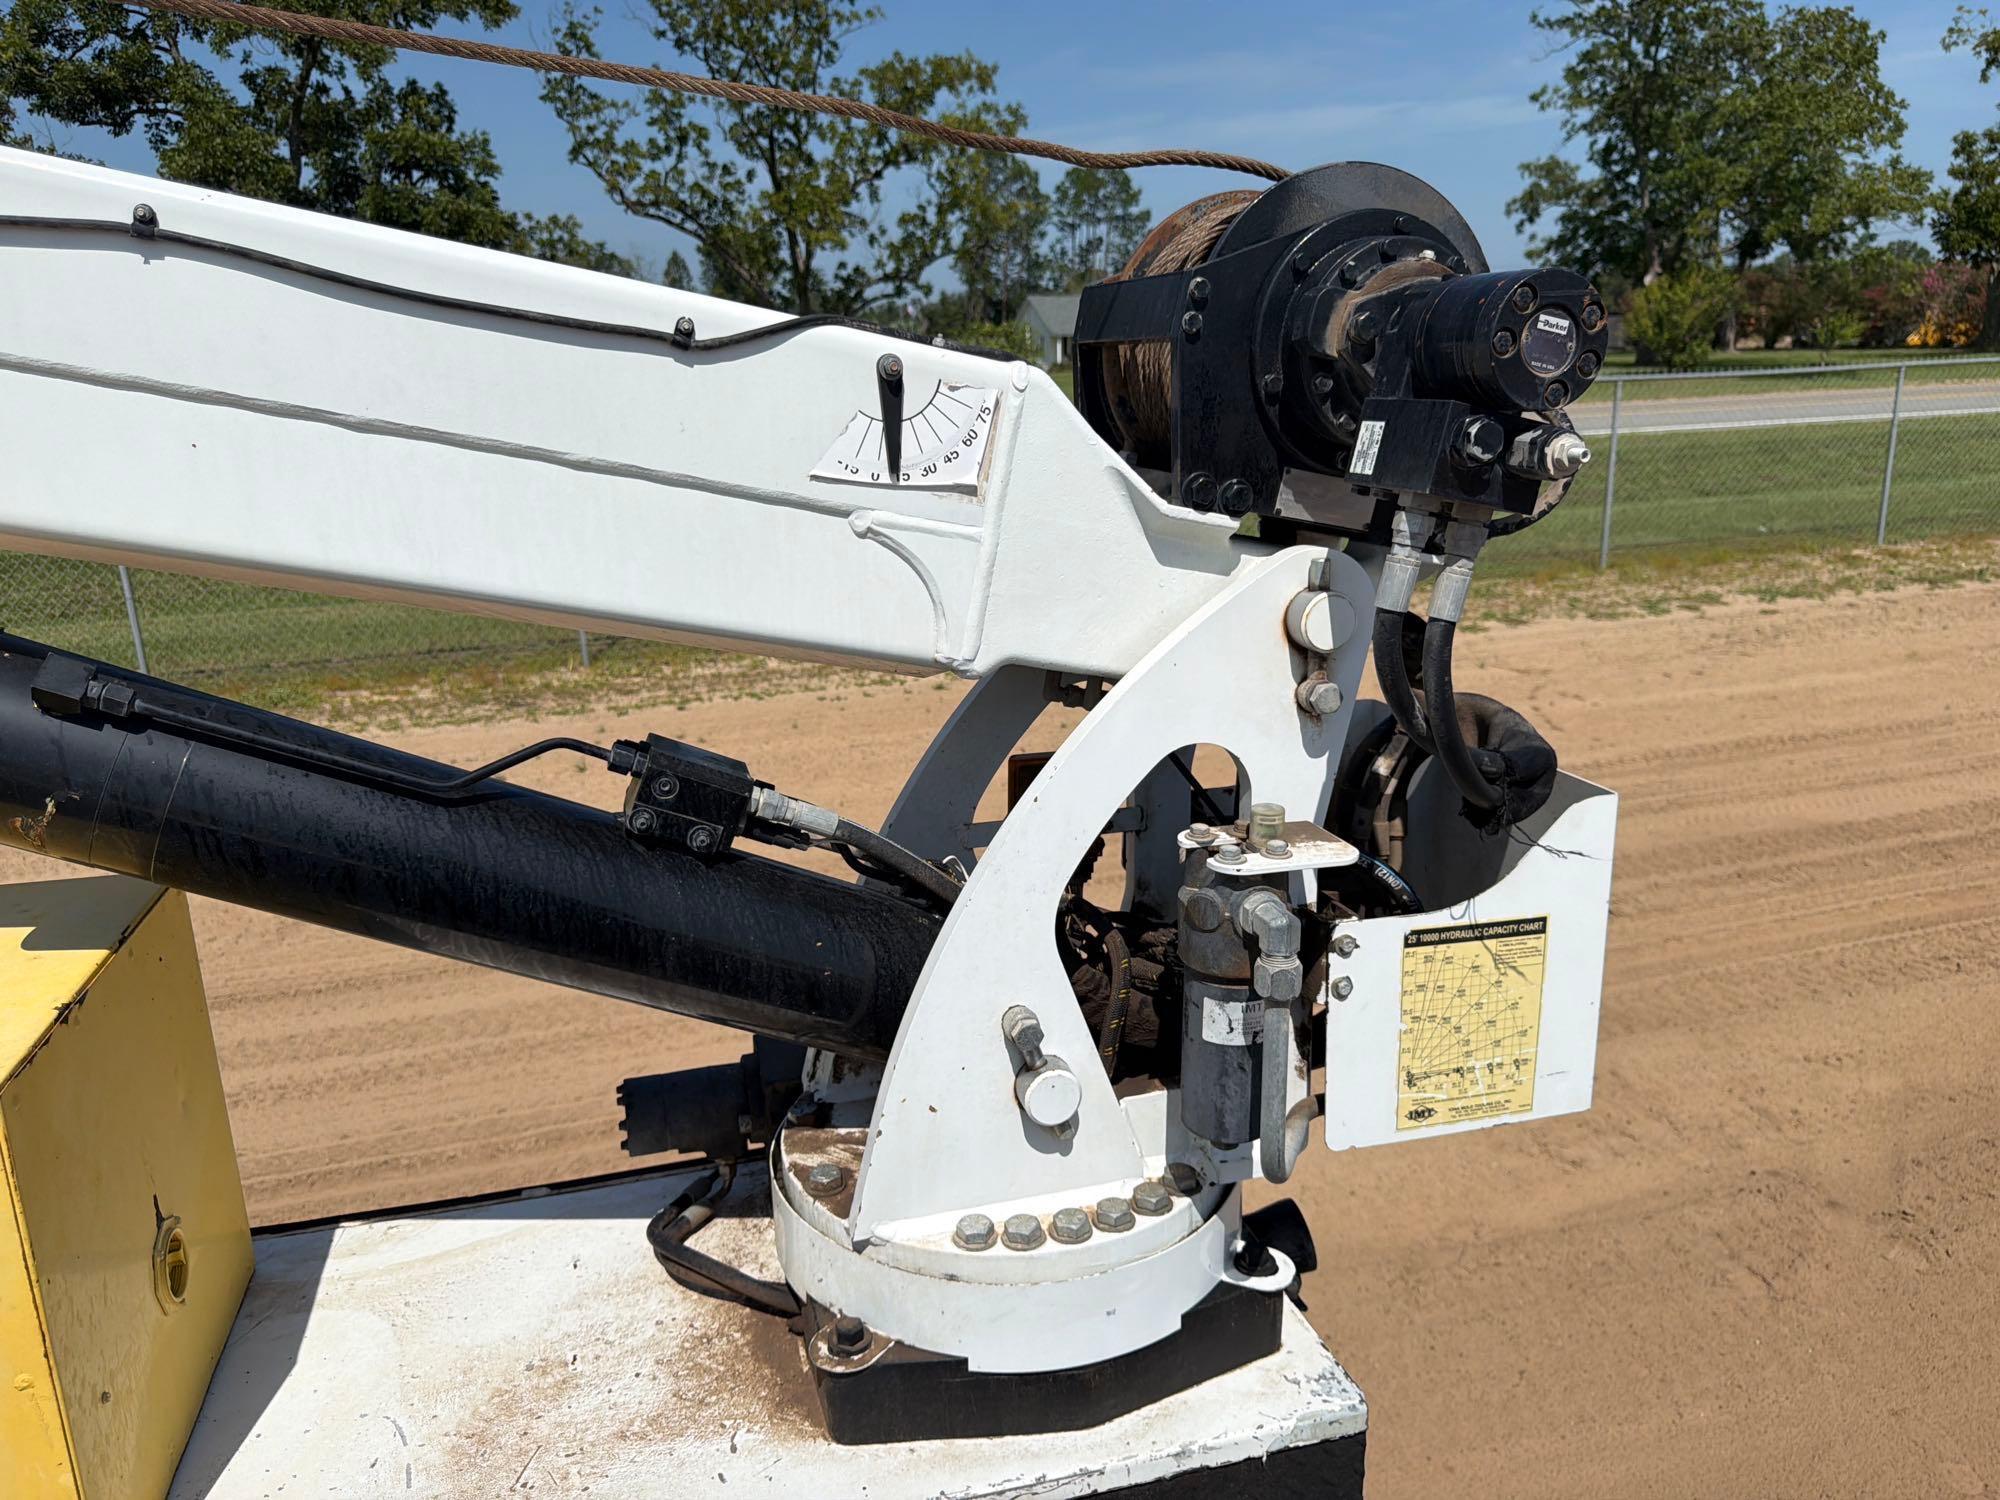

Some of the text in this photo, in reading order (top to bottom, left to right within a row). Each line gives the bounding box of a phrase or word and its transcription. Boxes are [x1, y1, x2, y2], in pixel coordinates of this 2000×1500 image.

[1542, 319, 1567, 332] Parker
[921, 463, 937, 477] 30
[943, 450, 959, 465] 45
[962, 428, 978, 447] 60
[976, 405, 991, 424] 75
[1420, 933, 1440, 943] 10000
[1440, 928, 1482, 940] HYDRAULIC
[1483, 924, 1519, 936] CAPACITY
[1519, 921, 1544, 932] CHART
[1241, 1003, 1262, 1013] IMT
[1407, 1107, 1435, 1120] IMT
